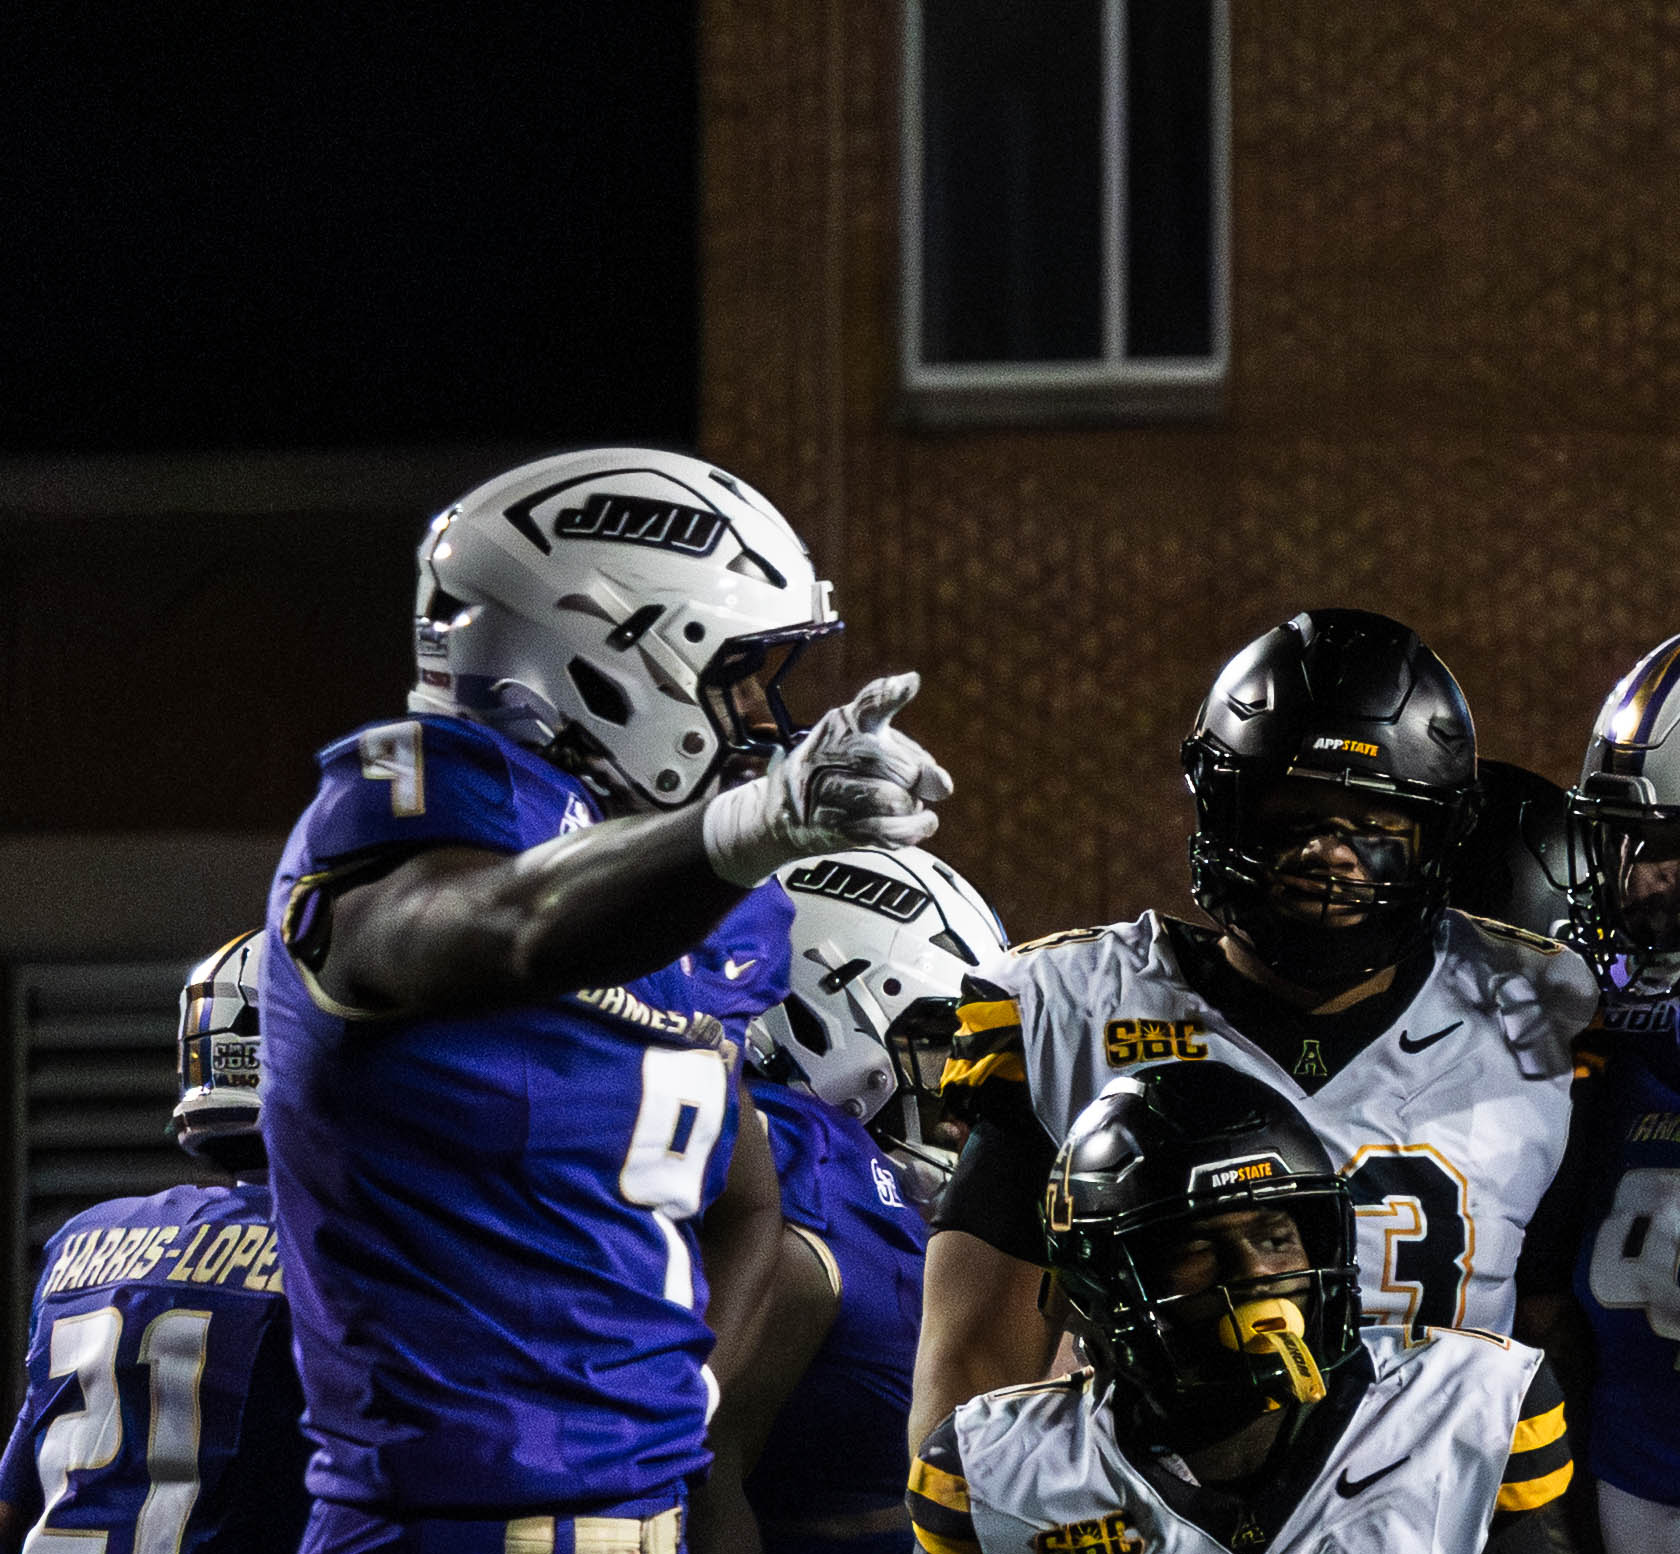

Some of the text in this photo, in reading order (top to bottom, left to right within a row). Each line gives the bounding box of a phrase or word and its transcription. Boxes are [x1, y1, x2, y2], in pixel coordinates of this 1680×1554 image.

[554, 493, 729, 558] JMU
[786, 860, 933, 924] JMU
[1104, 1018, 1209, 1068] SBC
